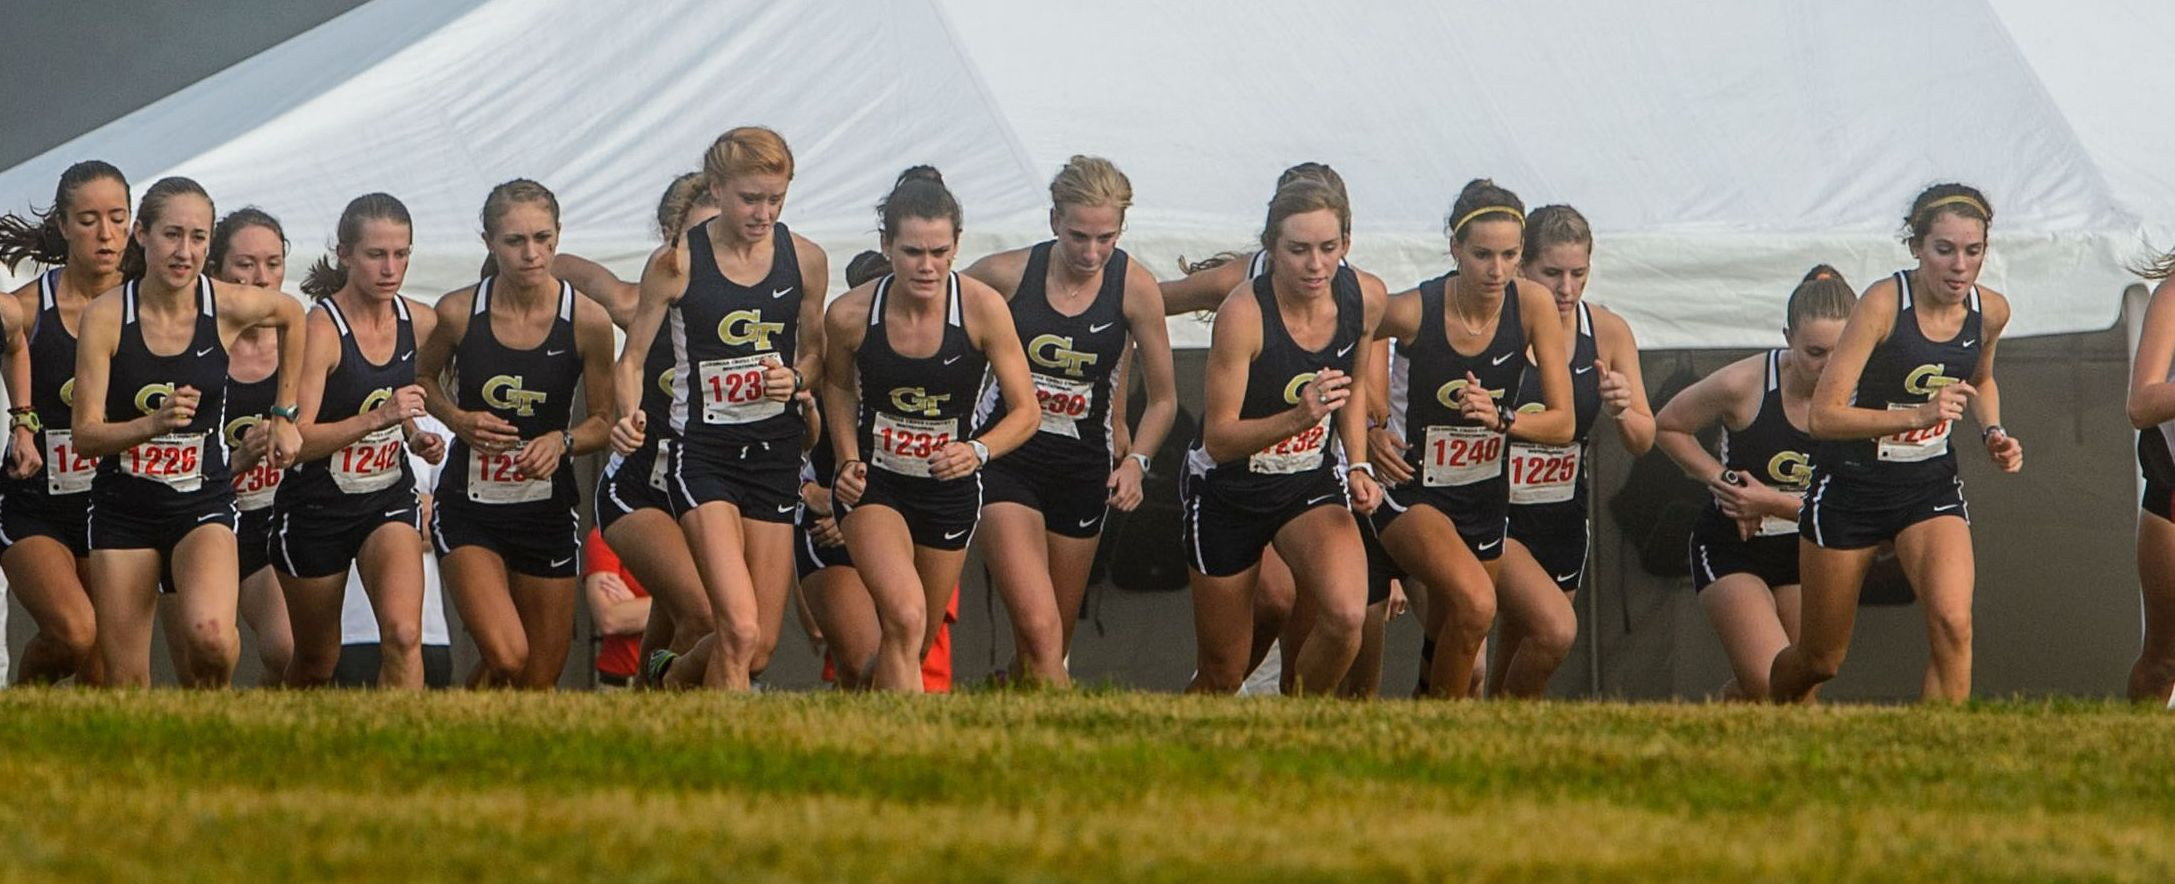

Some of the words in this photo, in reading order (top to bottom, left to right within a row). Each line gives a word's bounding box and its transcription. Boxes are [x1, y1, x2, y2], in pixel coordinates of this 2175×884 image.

[717, 309, 785, 351] GT
[1028, 333, 1098, 376] GT
[481, 374, 547, 417] GT
[709, 370, 767, 404] 123
[888, 387, 951, 416] GT
[881, 427, 949, 458] 1234
[1263, 425, 1324, 455] 232
[1434, 437, 1501, 467] 1240
[54, 444, 98, 473] 12
[129, 445, 198, 475] 1226
[340, 440, 400, 474] 1242
[1511, 454, 1575, 484] 1225
